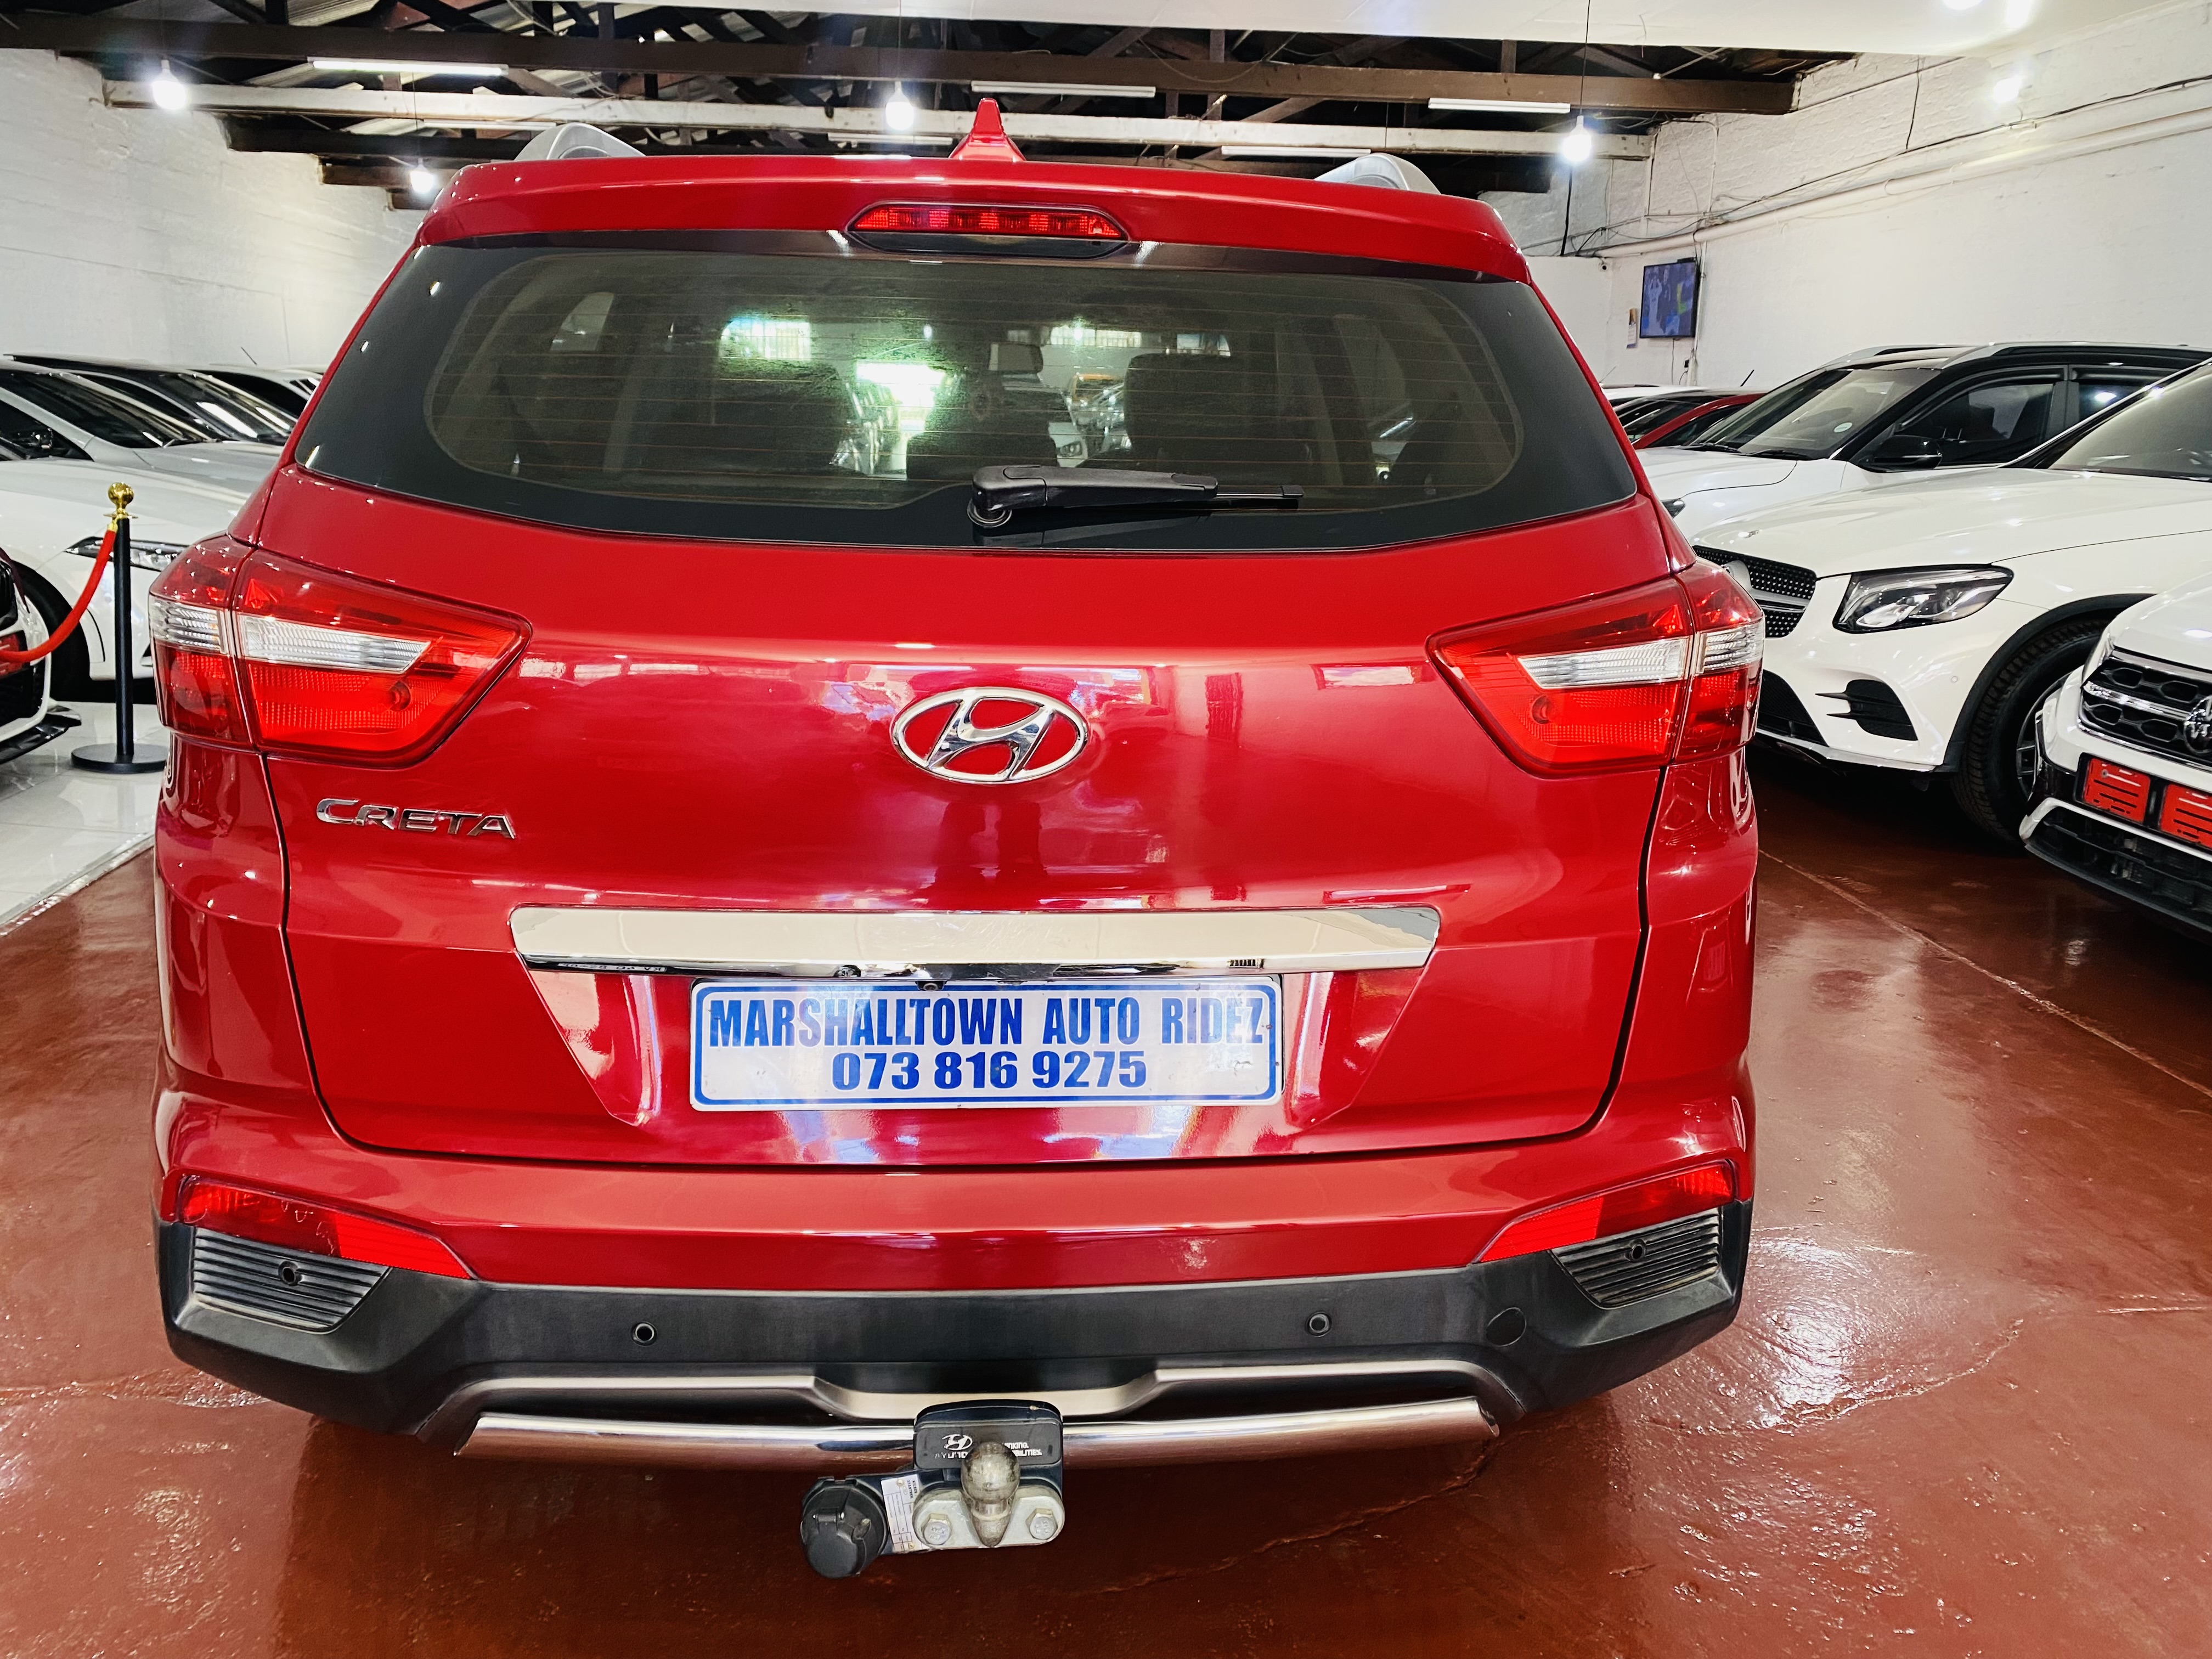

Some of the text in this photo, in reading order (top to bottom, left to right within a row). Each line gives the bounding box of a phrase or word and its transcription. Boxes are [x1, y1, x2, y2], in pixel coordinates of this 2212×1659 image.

[316, 797, 516, 839] CRETA
[709, 997, 1263, 1047] MARSHALLTOWN AUTO RIDEZ
[832, 1051, 1147, 1090] 073 816 9275
